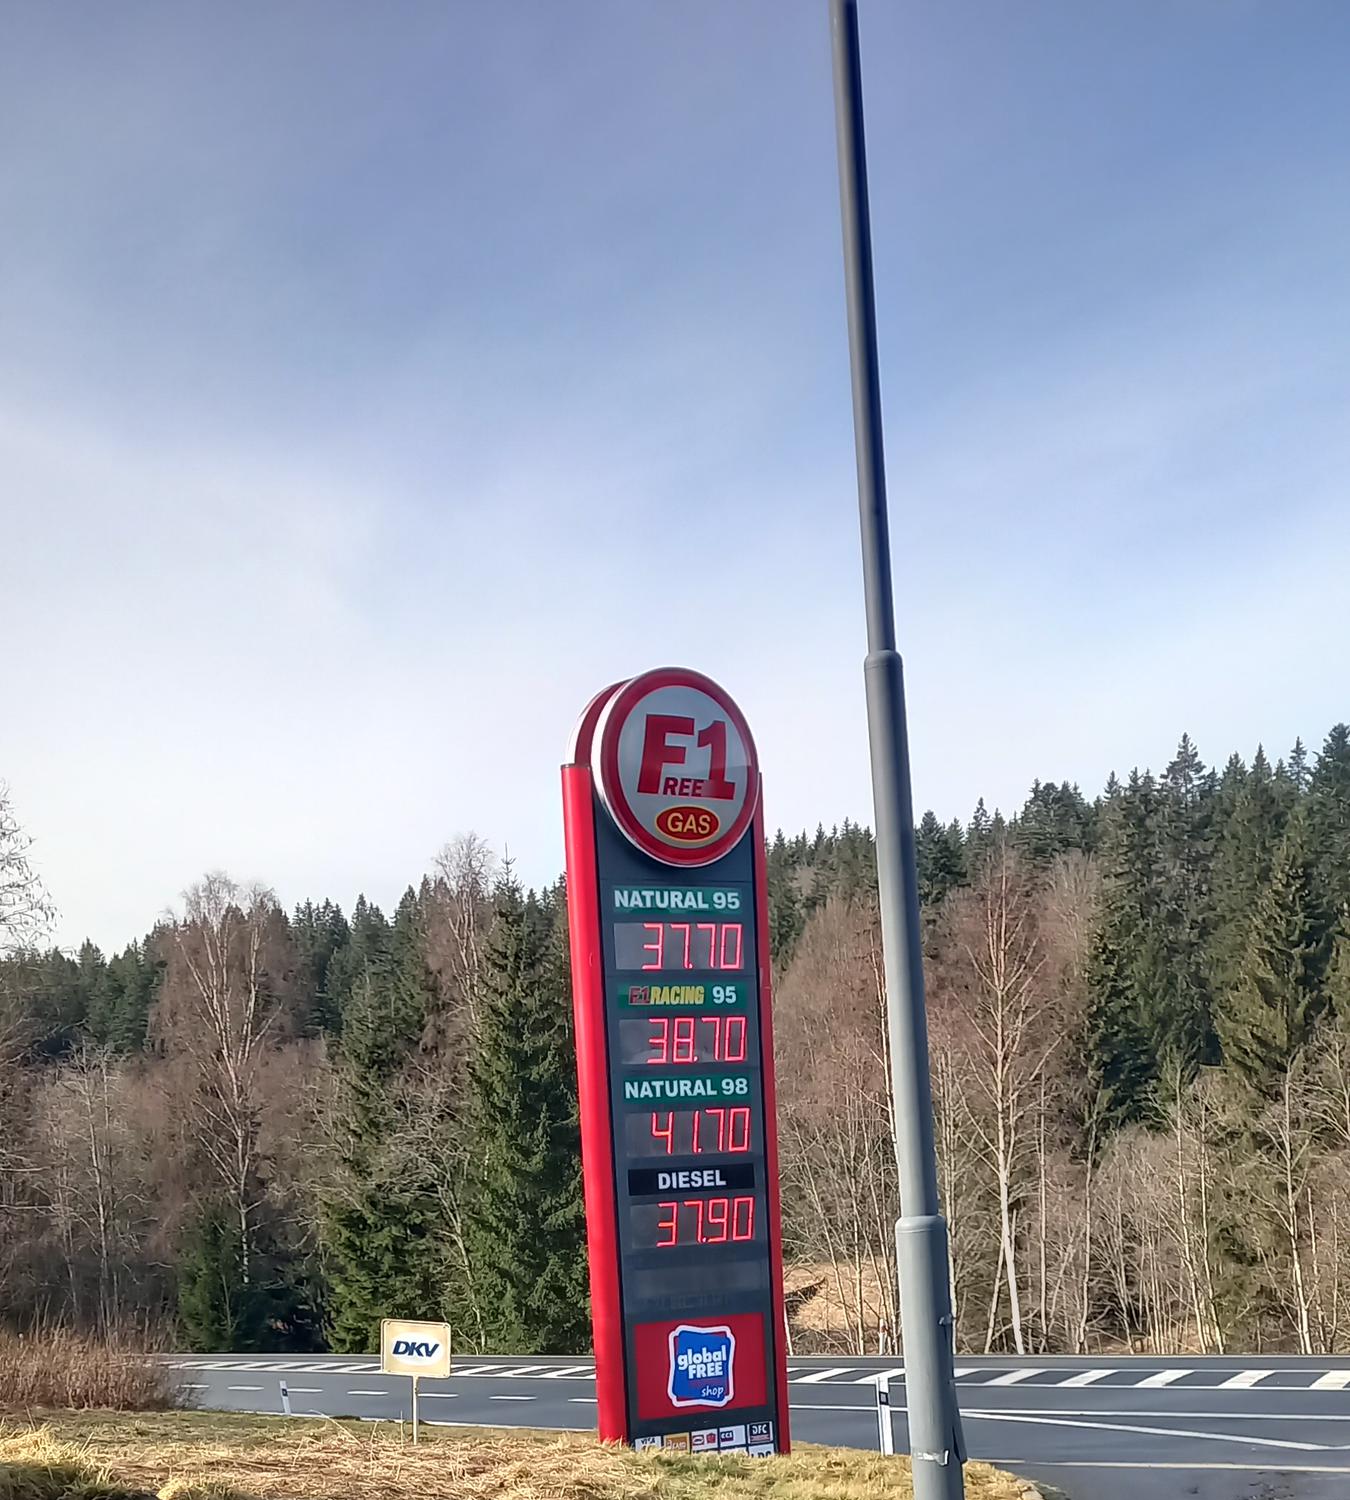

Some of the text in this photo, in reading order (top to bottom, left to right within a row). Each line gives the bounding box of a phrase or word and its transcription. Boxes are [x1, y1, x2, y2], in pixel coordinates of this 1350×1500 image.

[667, 812, 711, 835] GAS
[614, 890, 740, 909] NATURAL 95
[642, 922, 743, 970] 37.70
[712, 986, 737, 1004] 95
[647, 1016, 747, 1064] 38.70
[624, 1078, 748, 1099] NATURAL 98
[652, 1107, 751, 1155] 41.70
[657, 1169, 727, 1190] DIESEL
[656, 1196, 754, 1248] 37.90
[392, 1340, 440, 1357] DKV
[677, 1344, 727, 1371] global
[688, 1362, 724, 1380] FREE
[701, 1385, 724, 1398] shop
